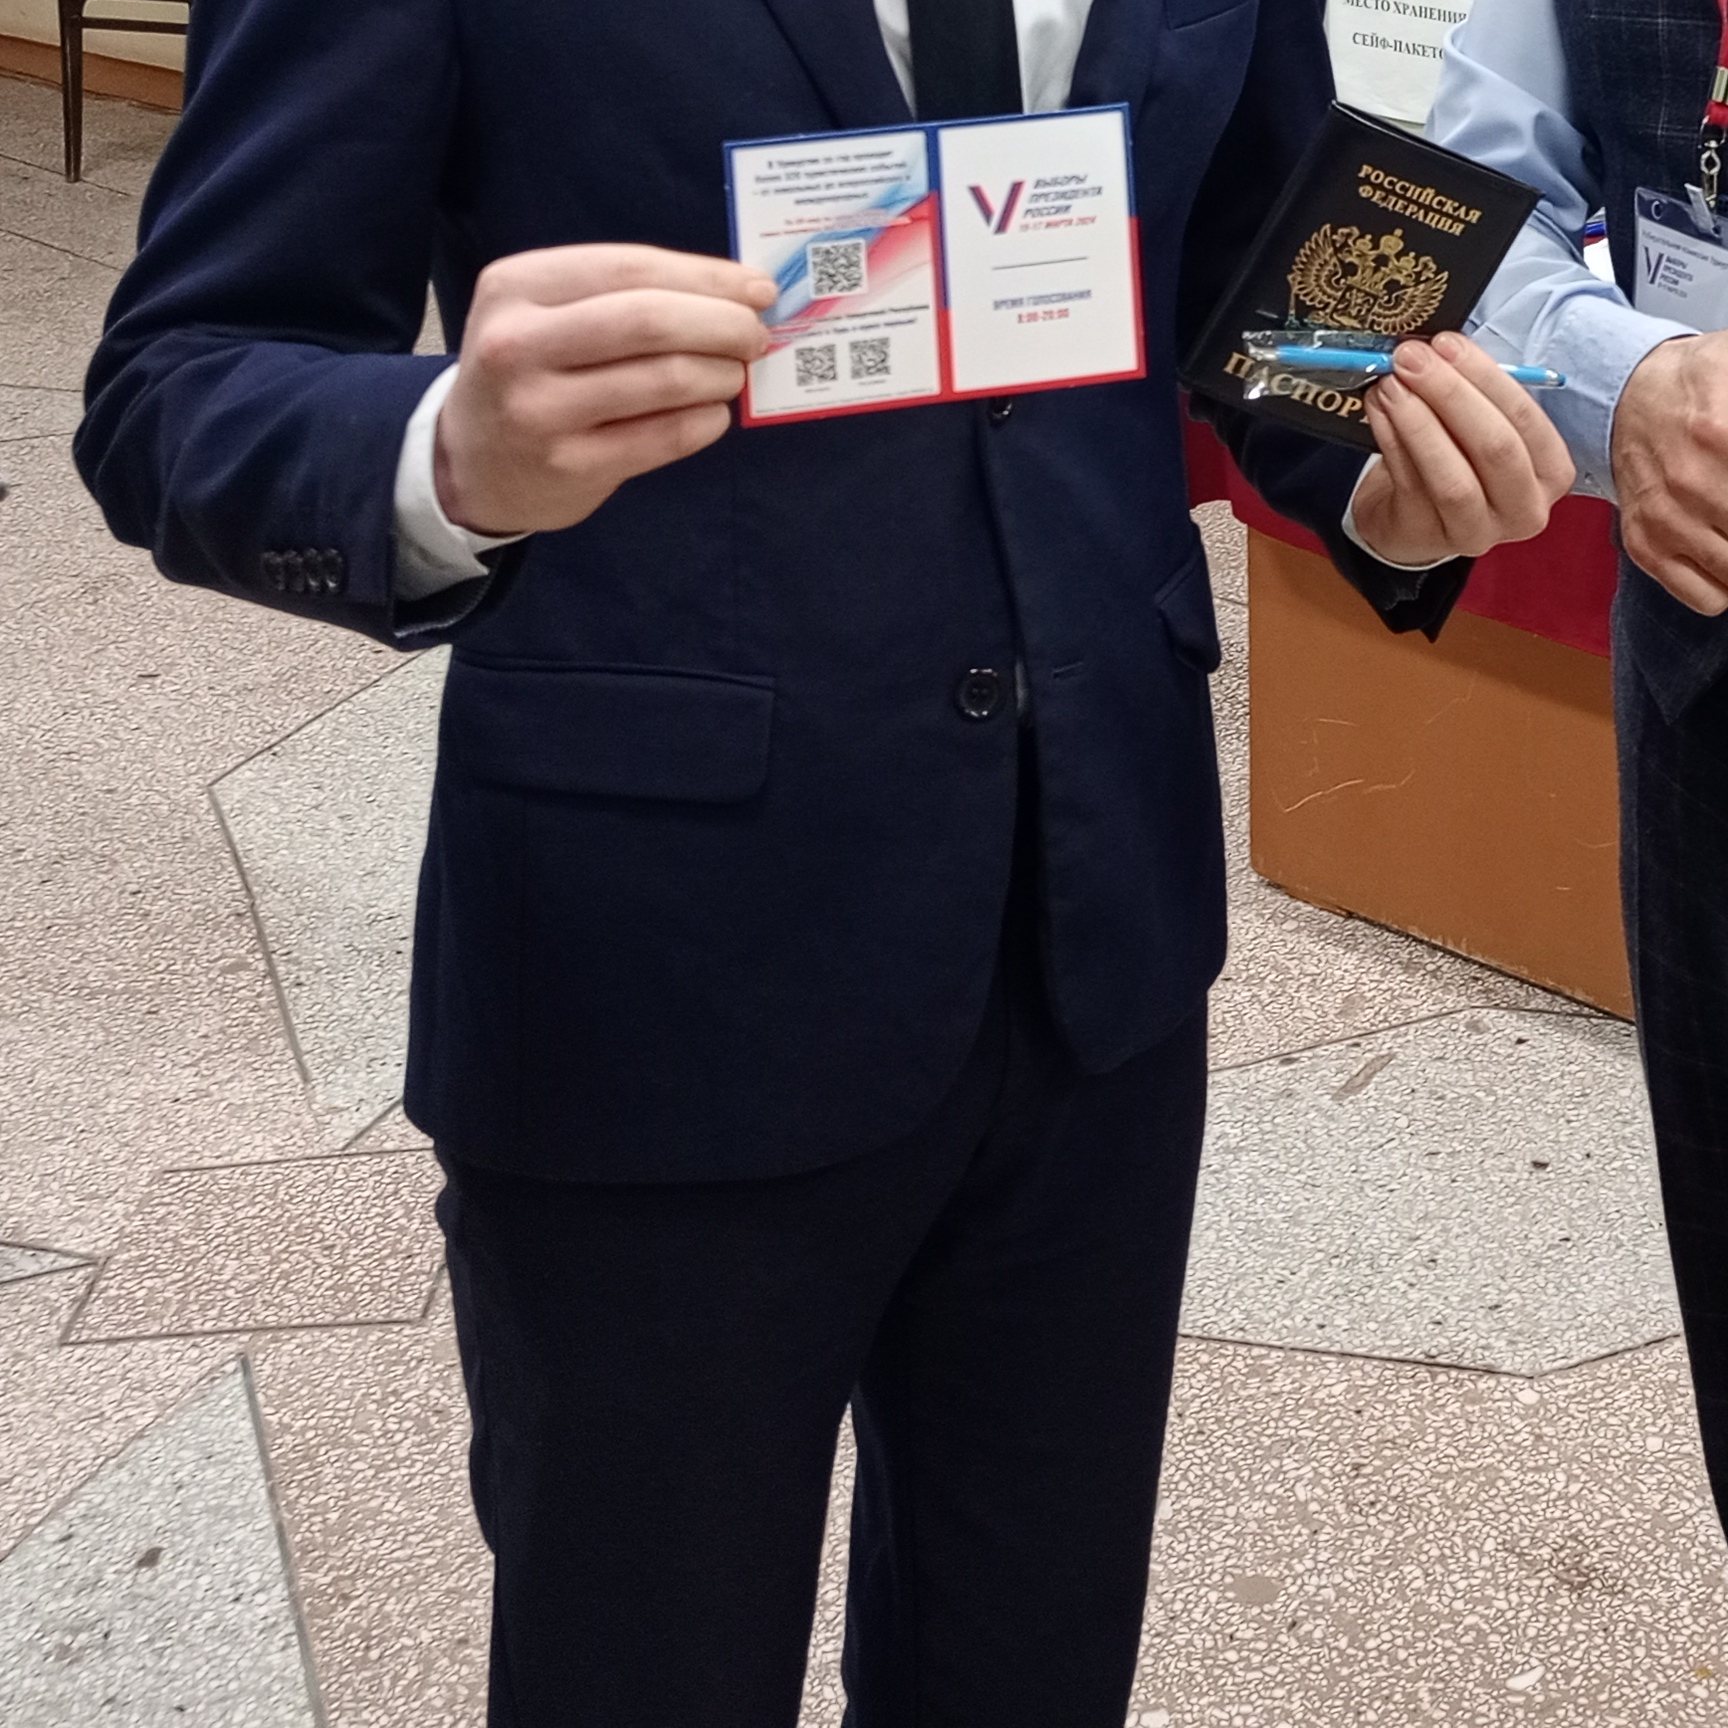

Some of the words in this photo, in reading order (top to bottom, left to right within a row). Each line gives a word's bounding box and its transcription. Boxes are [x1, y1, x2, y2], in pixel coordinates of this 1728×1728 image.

[1357, 164, 1482, 224] РОССИЙСКАЯ
[1358, 184, 1466, 237] ФЕДЕРАЦИЯ
[1223, 351, 1371, 424] ПАСПОР
